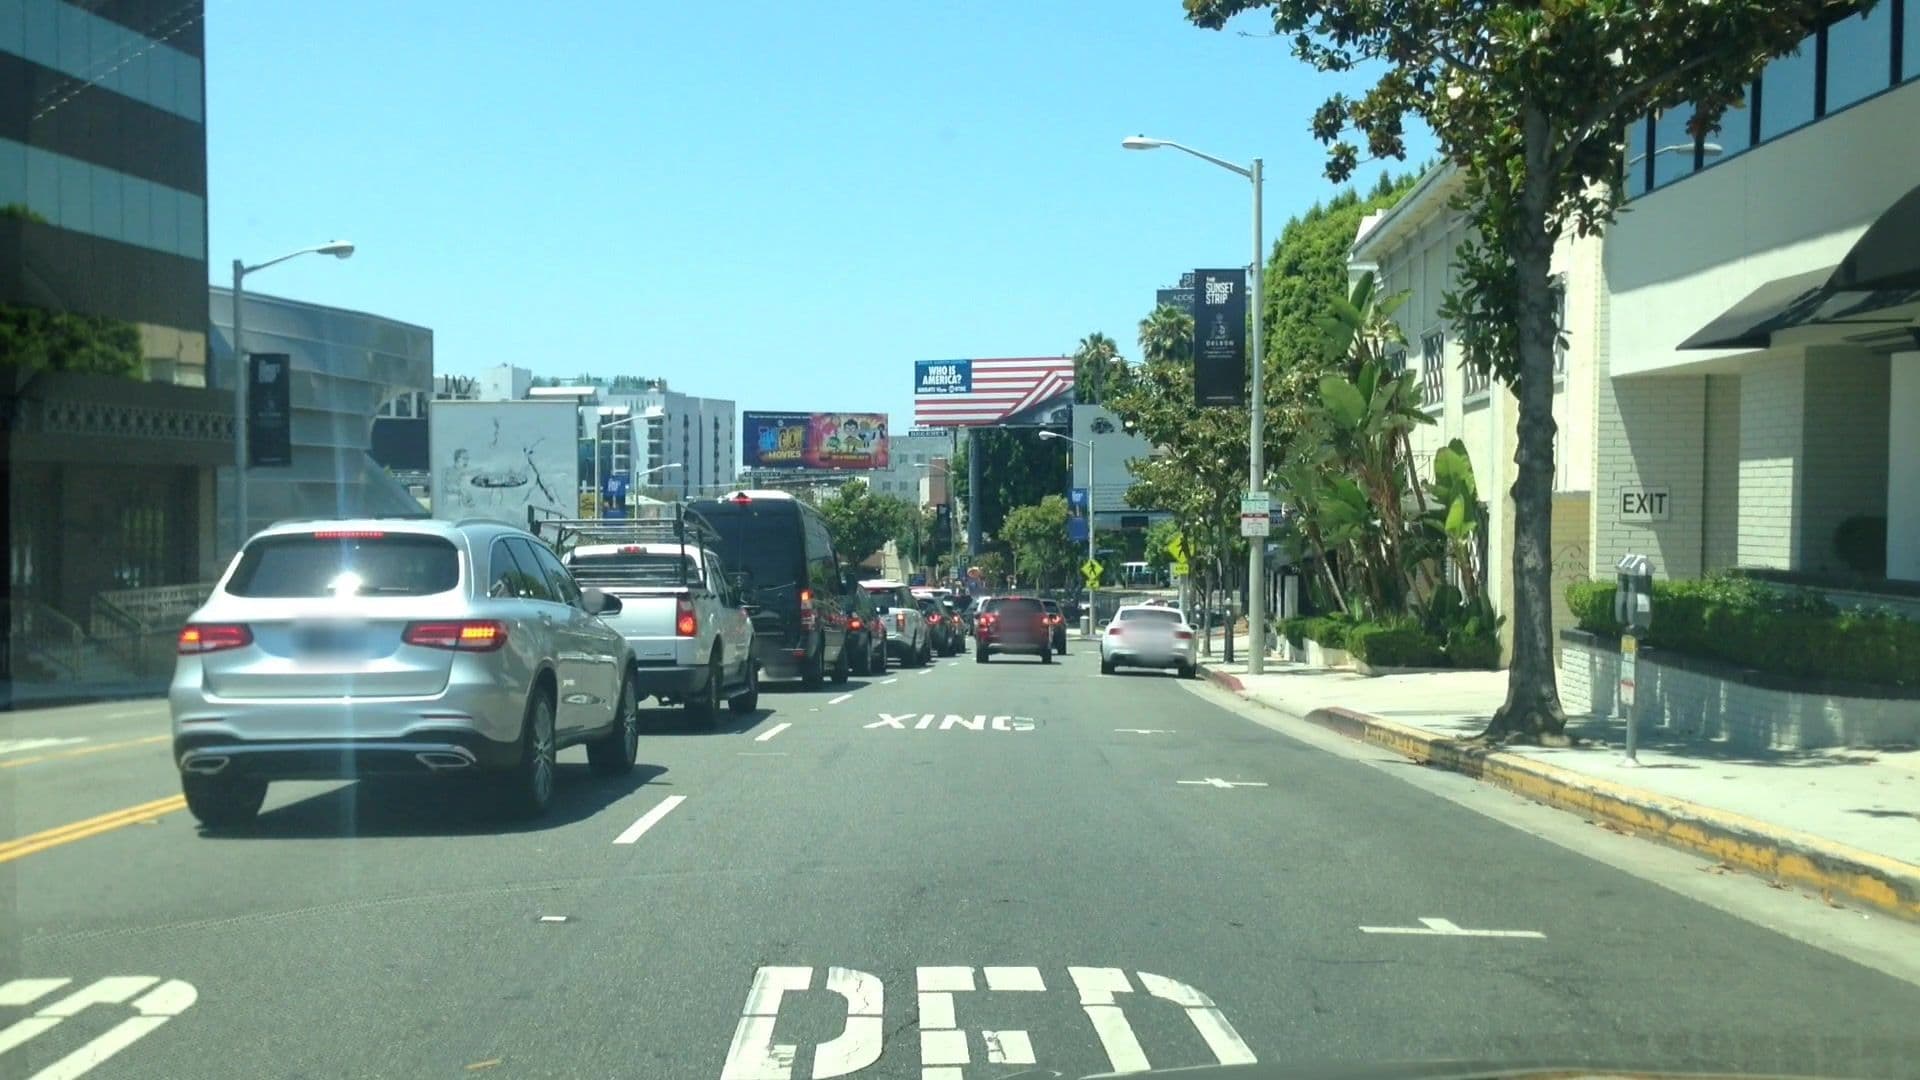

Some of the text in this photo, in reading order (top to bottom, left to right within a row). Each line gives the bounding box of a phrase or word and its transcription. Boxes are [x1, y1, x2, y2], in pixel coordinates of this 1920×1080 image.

[1205, 282, 1234, 294] SUNSET
[1205, 293, 1228, 305] STRIP
[928, 365, 956, 376] WHO IS
[922, 374, 962, 385] AMERICA?
[768, 450, 801, 458] MOVIES
[1623, 493, 1667, 514] EXIT
[862, 713, 1035, 731] XING
[720, 965, 1257, 1080] PED
